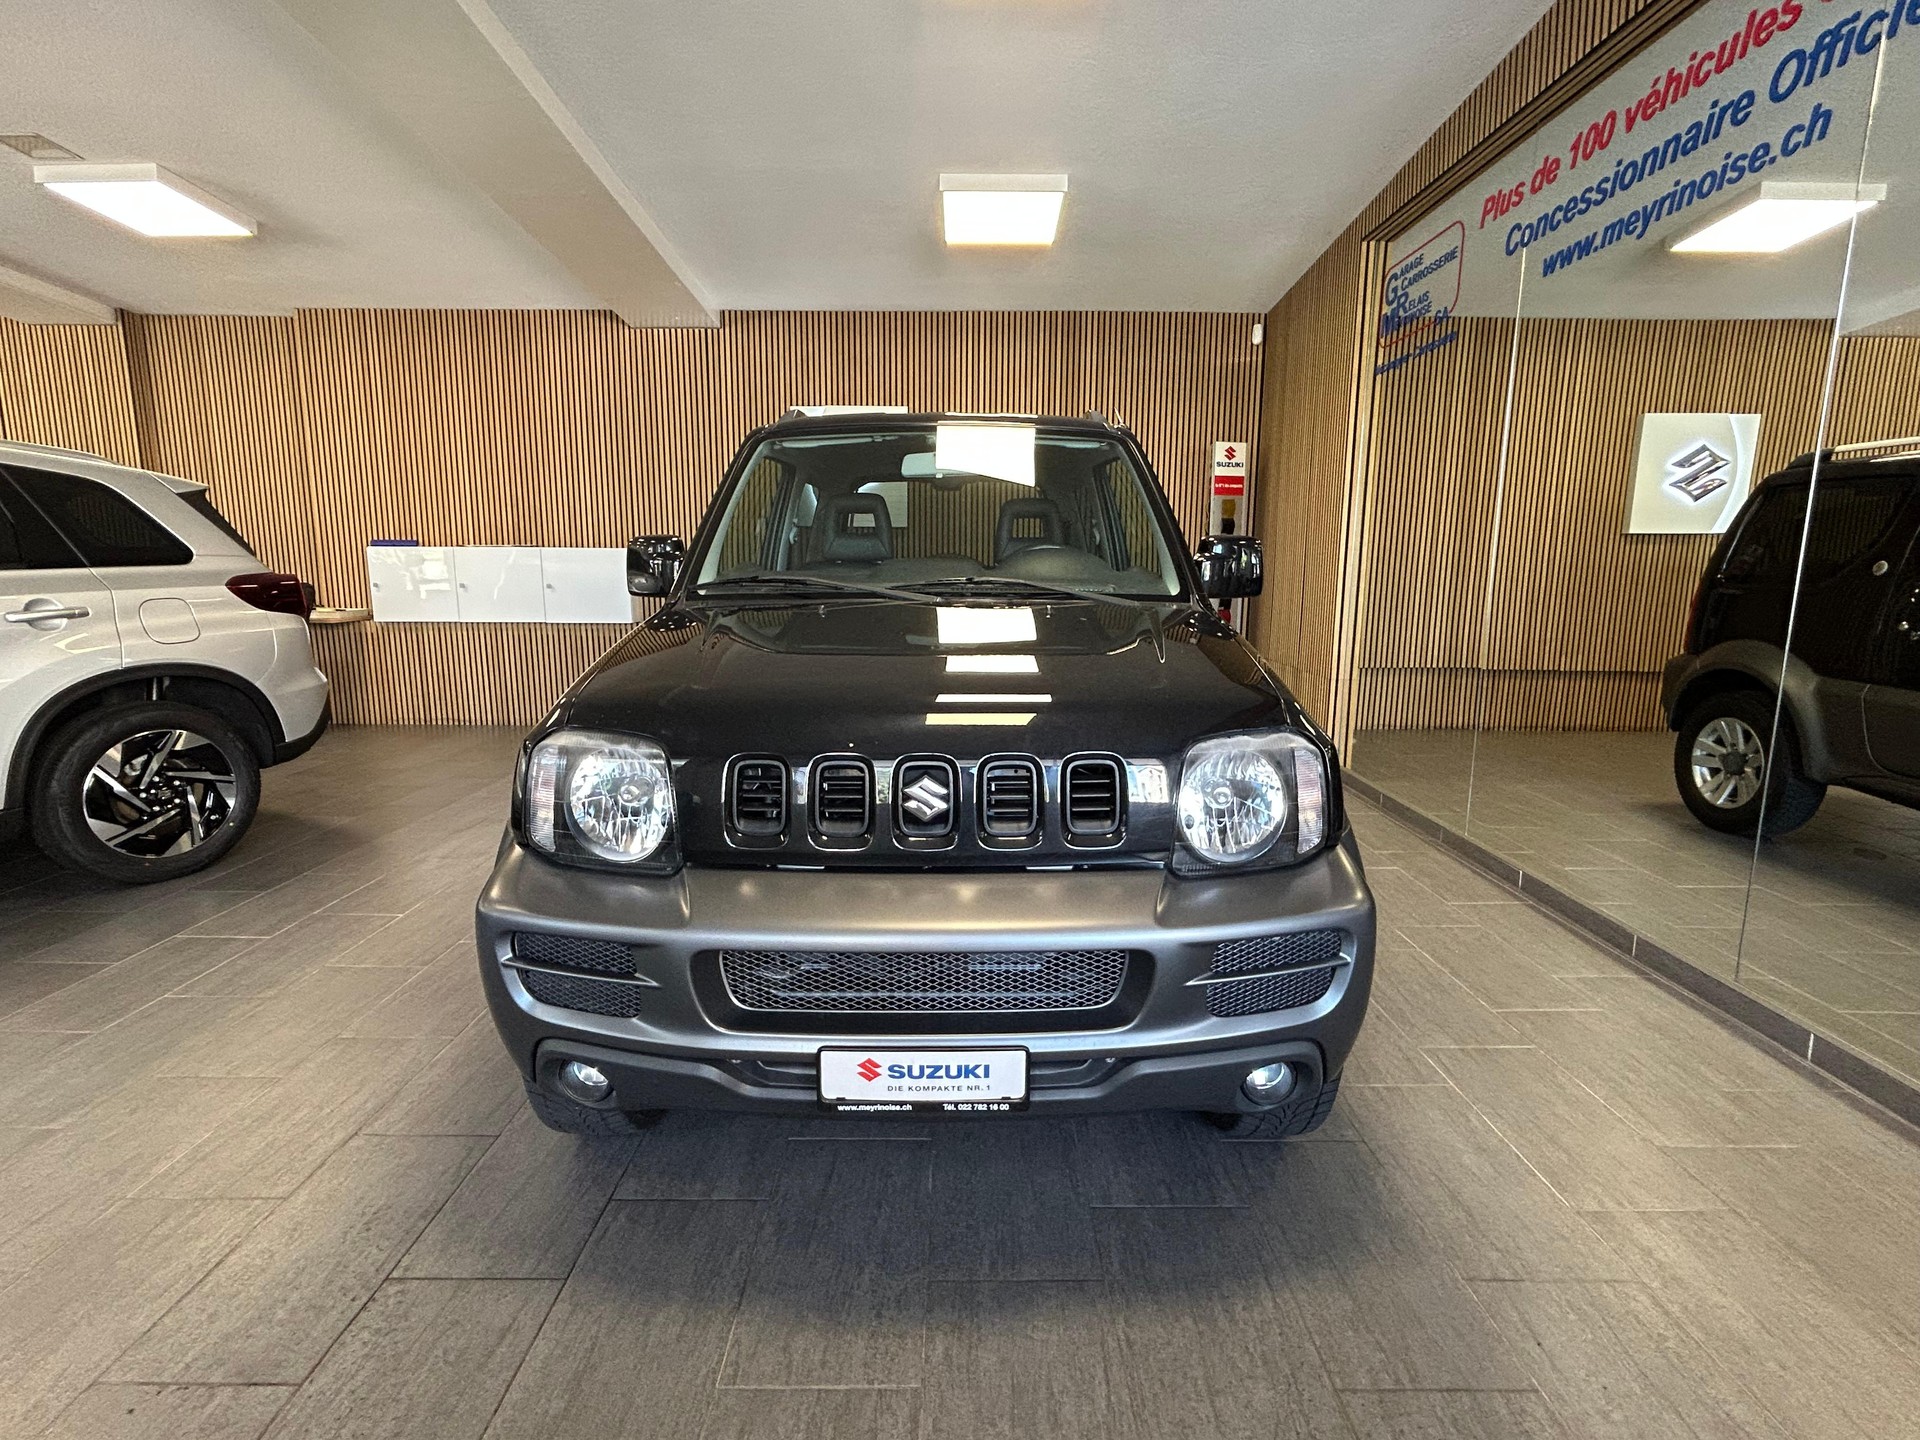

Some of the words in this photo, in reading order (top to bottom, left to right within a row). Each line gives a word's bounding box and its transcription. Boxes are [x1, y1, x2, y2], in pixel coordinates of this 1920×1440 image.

[1480, 182, 1526, 229] Plus
[1530, 155, 1561, 195] de
[1569, 109, 1617, 170] 100
[1625, 0, 1803, 134] véhicules
[1505, 89, 1756, 256] Concessionnaire
[1542, 102, 1833, 278] www.meyrinoise.ch
[1385, 253, 1424, 306] GARAGE
[1401, 246, 1459, 291] CARROSSERIE
[1396, 291, 1430, 318] RELAIS
[888, 1063, 991, 1080] SUZUKI
[837, 1104, 912, 1112] www.meyrinoise.ch
